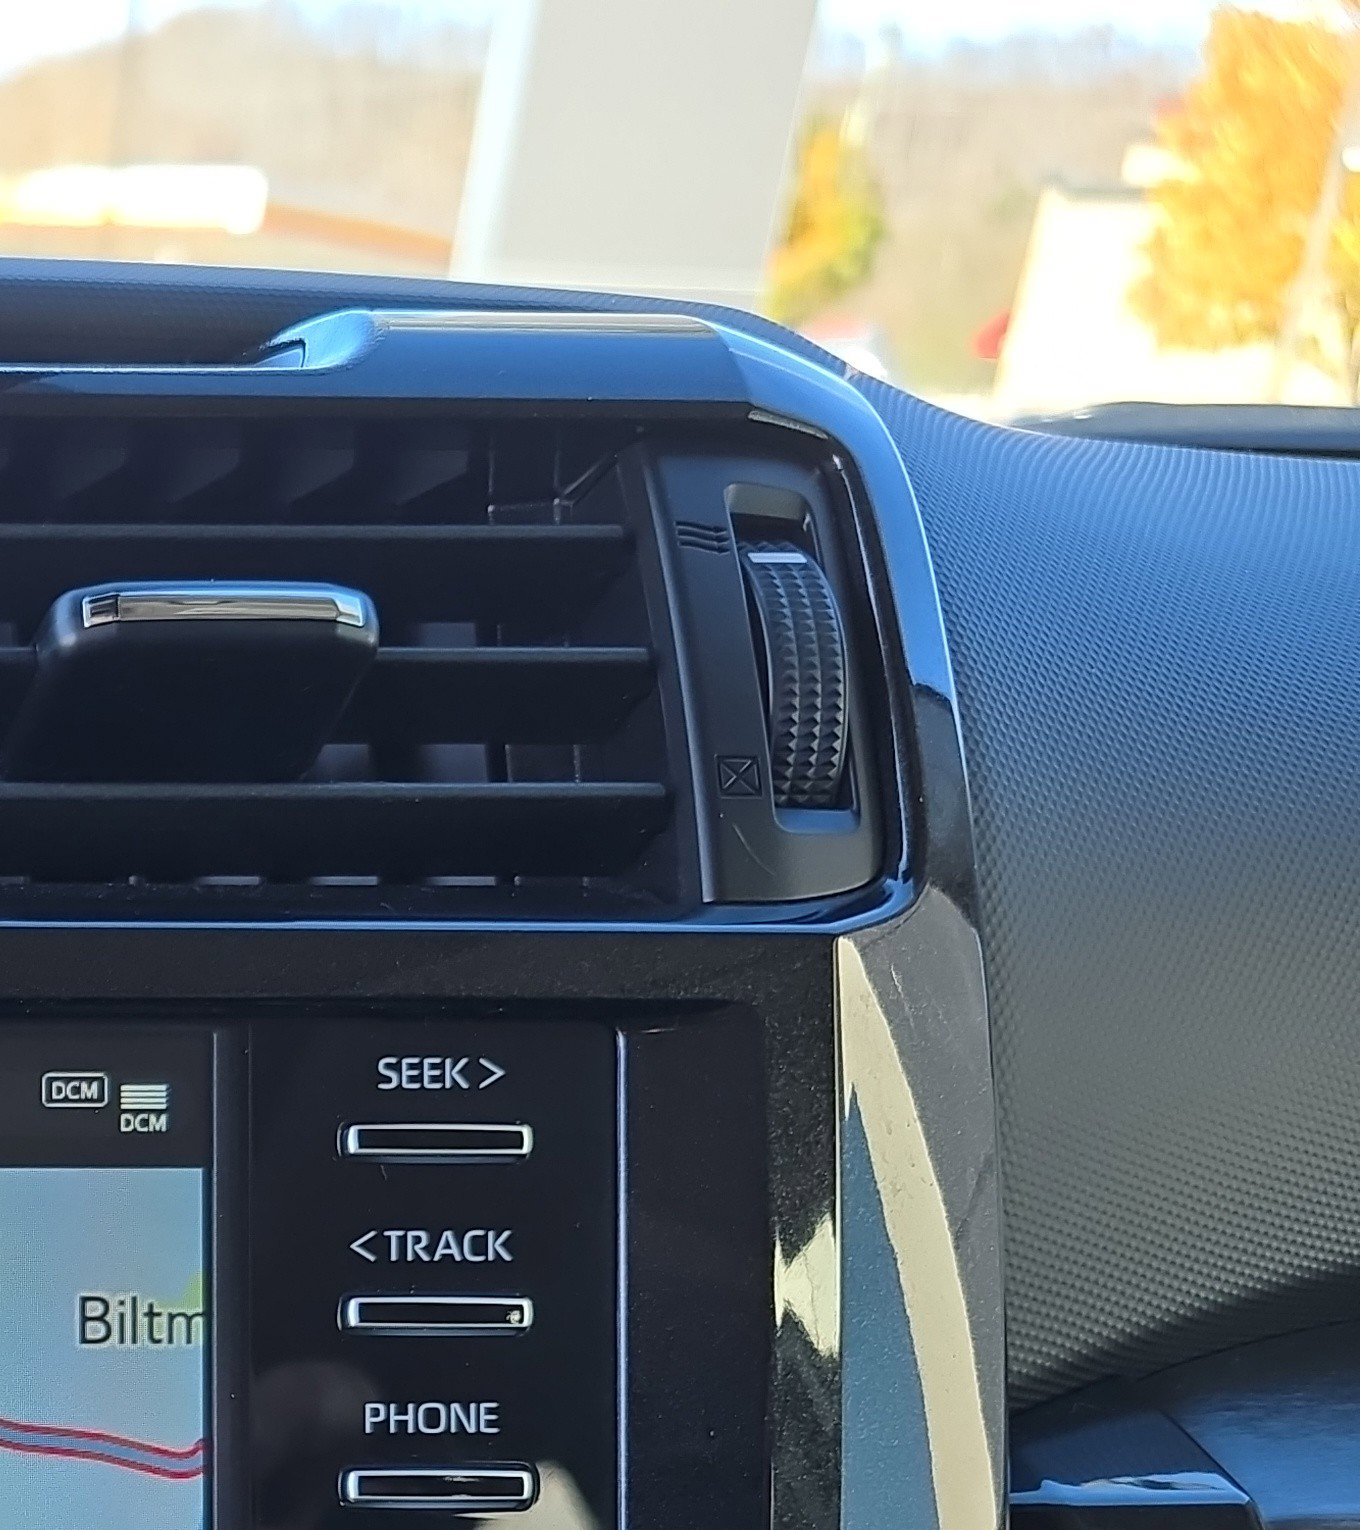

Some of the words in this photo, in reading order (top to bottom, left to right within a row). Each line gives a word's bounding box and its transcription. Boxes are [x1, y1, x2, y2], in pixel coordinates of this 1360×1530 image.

[51, 1080, 98, 1100] DCM
[120, 1113, 168, 1133] DCM
[363, 1401, 501, 1434] PHONE
